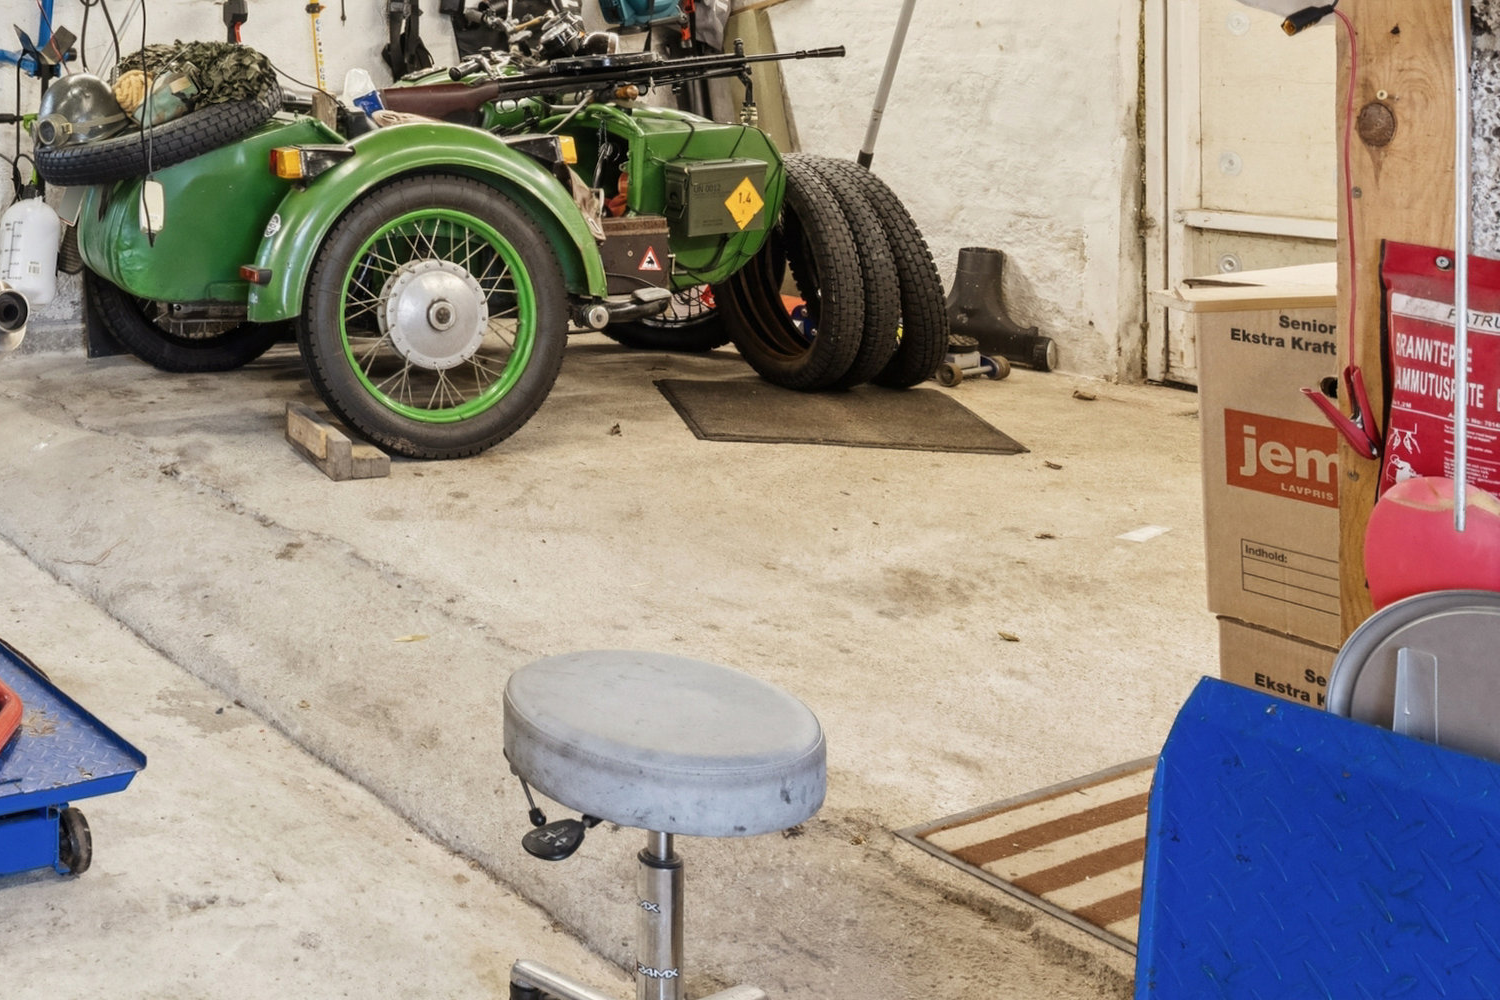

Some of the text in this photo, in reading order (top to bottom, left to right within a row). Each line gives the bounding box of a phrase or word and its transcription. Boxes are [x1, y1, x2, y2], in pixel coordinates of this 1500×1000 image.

[738, 192, 752, 204] 1.4
[1279, 315, 1337, 335] Senior
[1230, 328, 1337, 356] Ekstra Kraft
[1396, 332, 1473, 373] BRANNTEPE
[1281, 482, 1334, 501] LAVPRIS
[1245, 544, 1288, 564] Indhold:
[1255, 671, 1311, 703] Ekstra
